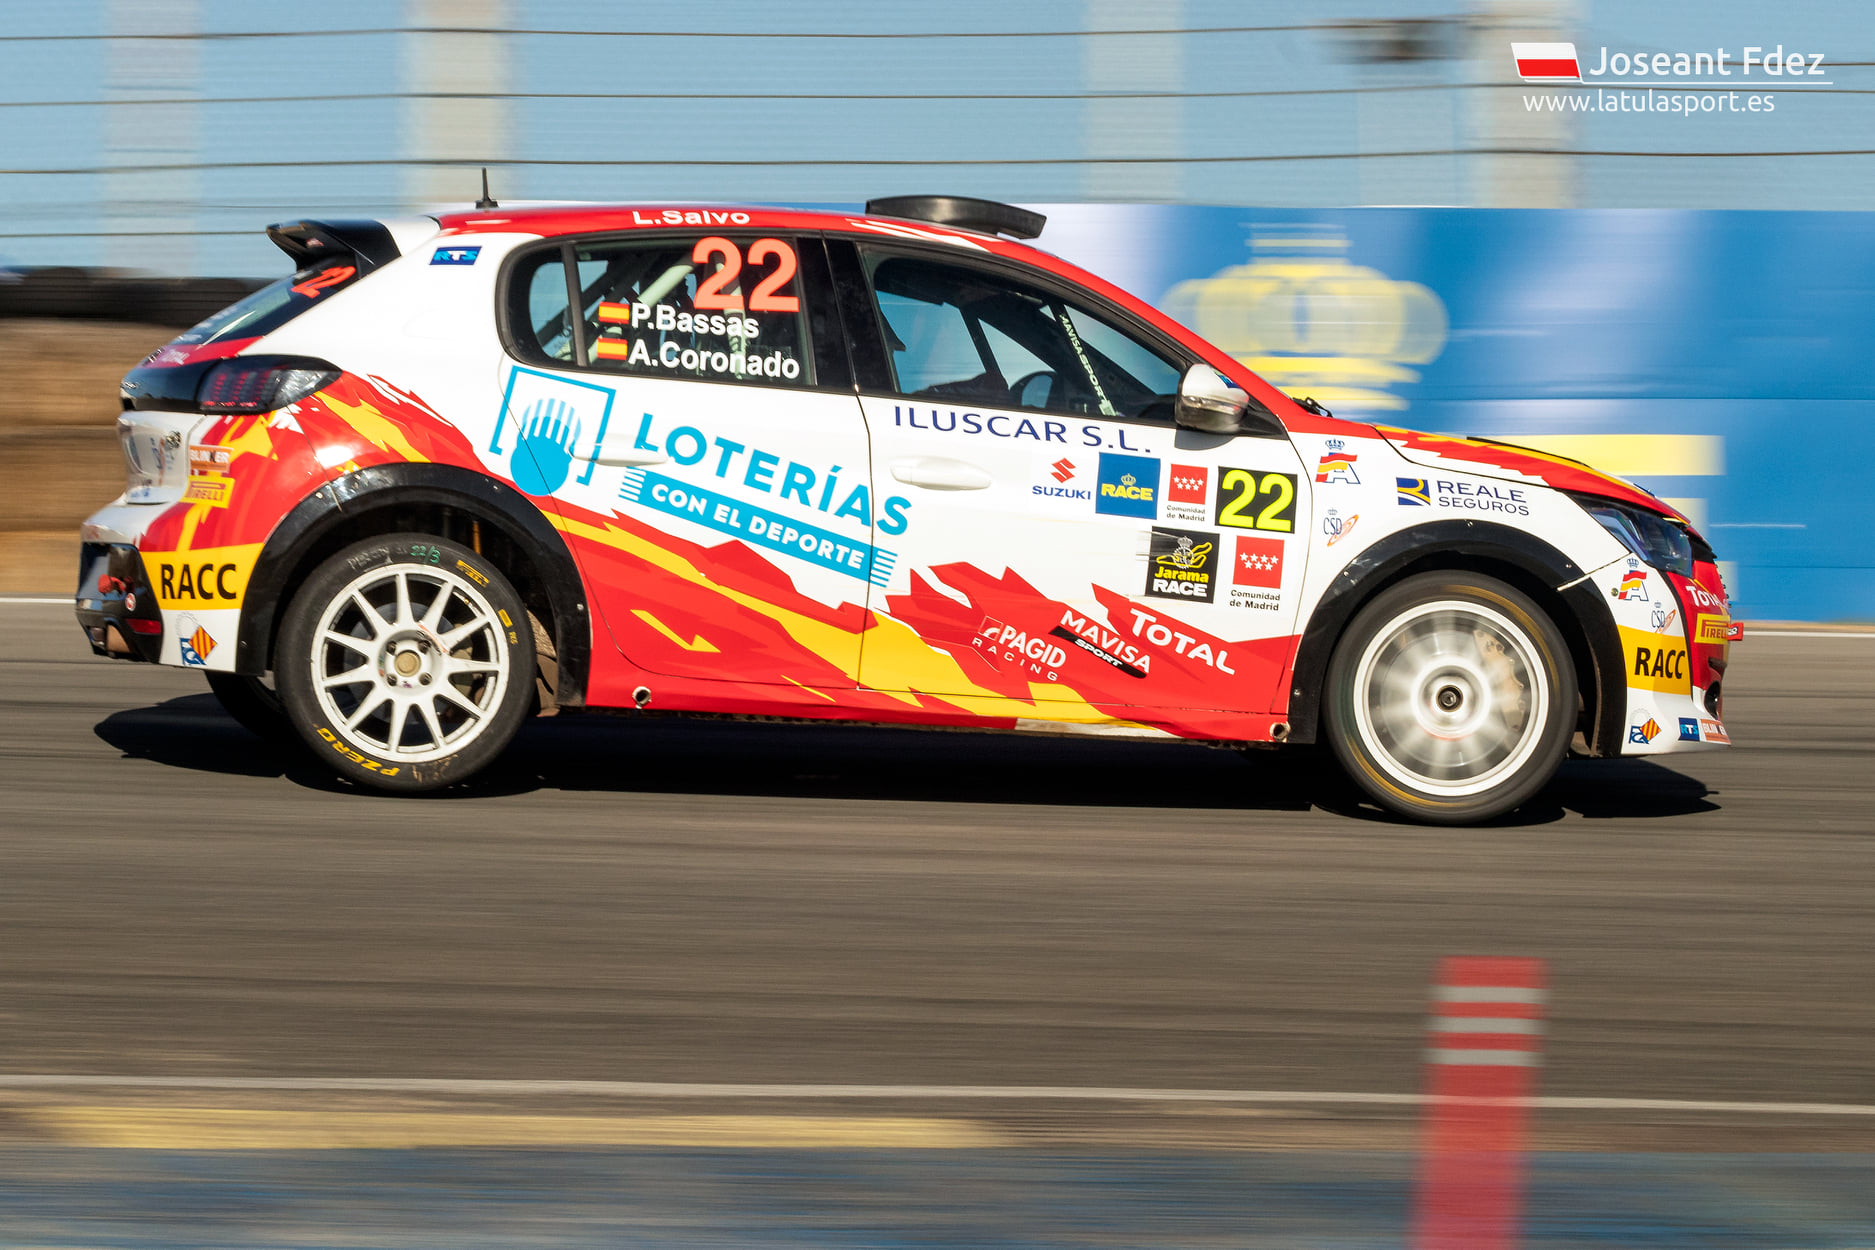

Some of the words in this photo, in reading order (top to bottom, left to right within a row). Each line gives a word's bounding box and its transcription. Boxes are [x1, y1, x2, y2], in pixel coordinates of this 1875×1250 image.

[632, 210, 751, 226] L.Salvo
[691, 236, 800, 313] 22
[631, 302, 760, 339] P.Bassas
[628, 339, 800, 380] A.Coronado
[893, 405, 1068, 444] ILUSCAR
[1082, 424, 1152, 454] S.L.
[633, 412, 913, 537] LOTERÍAS
[1031, 485, 1092, 501] SUZUKI
[1101, 483, 1154, 502] RACE
[1218, 469, 1294, 532] 22
[1436, 480, 1527, 504] REALE
[1438, 496, 1530, 517] SEGUROS
[1166, 504, 1206, 515] Comunidad
[1178, 513, 1206, 523] Madrid
[651, 483, 707, 516] CON
[713, 504, 743, 530] EL
[748, 517, 866, 570] DEPORTE
[1323, 517, 1343, 536] CSD
[159, 562, 237, 601] RACC
[1152, 578, 1208, 598] RACE
[1154, 566, 1209, 584] Jarama
[1229, 599, 1242, 608] de
[1244, 600, 1280, 612] Madrid
[1230, 589, 1281, 602] Comunidad
[999, 624, 1068, 669] PAGID
[1060, 609, 1153, 675] MAVISA
[1073, 638, 1124, 668] SPORT
[1128, 607, 1236, 677] TOTAL
[970, 636, 1059, 683] RACING
[1634, 646, 1686, 680] RACC
[1680, 724, 1699, 735] RTS
